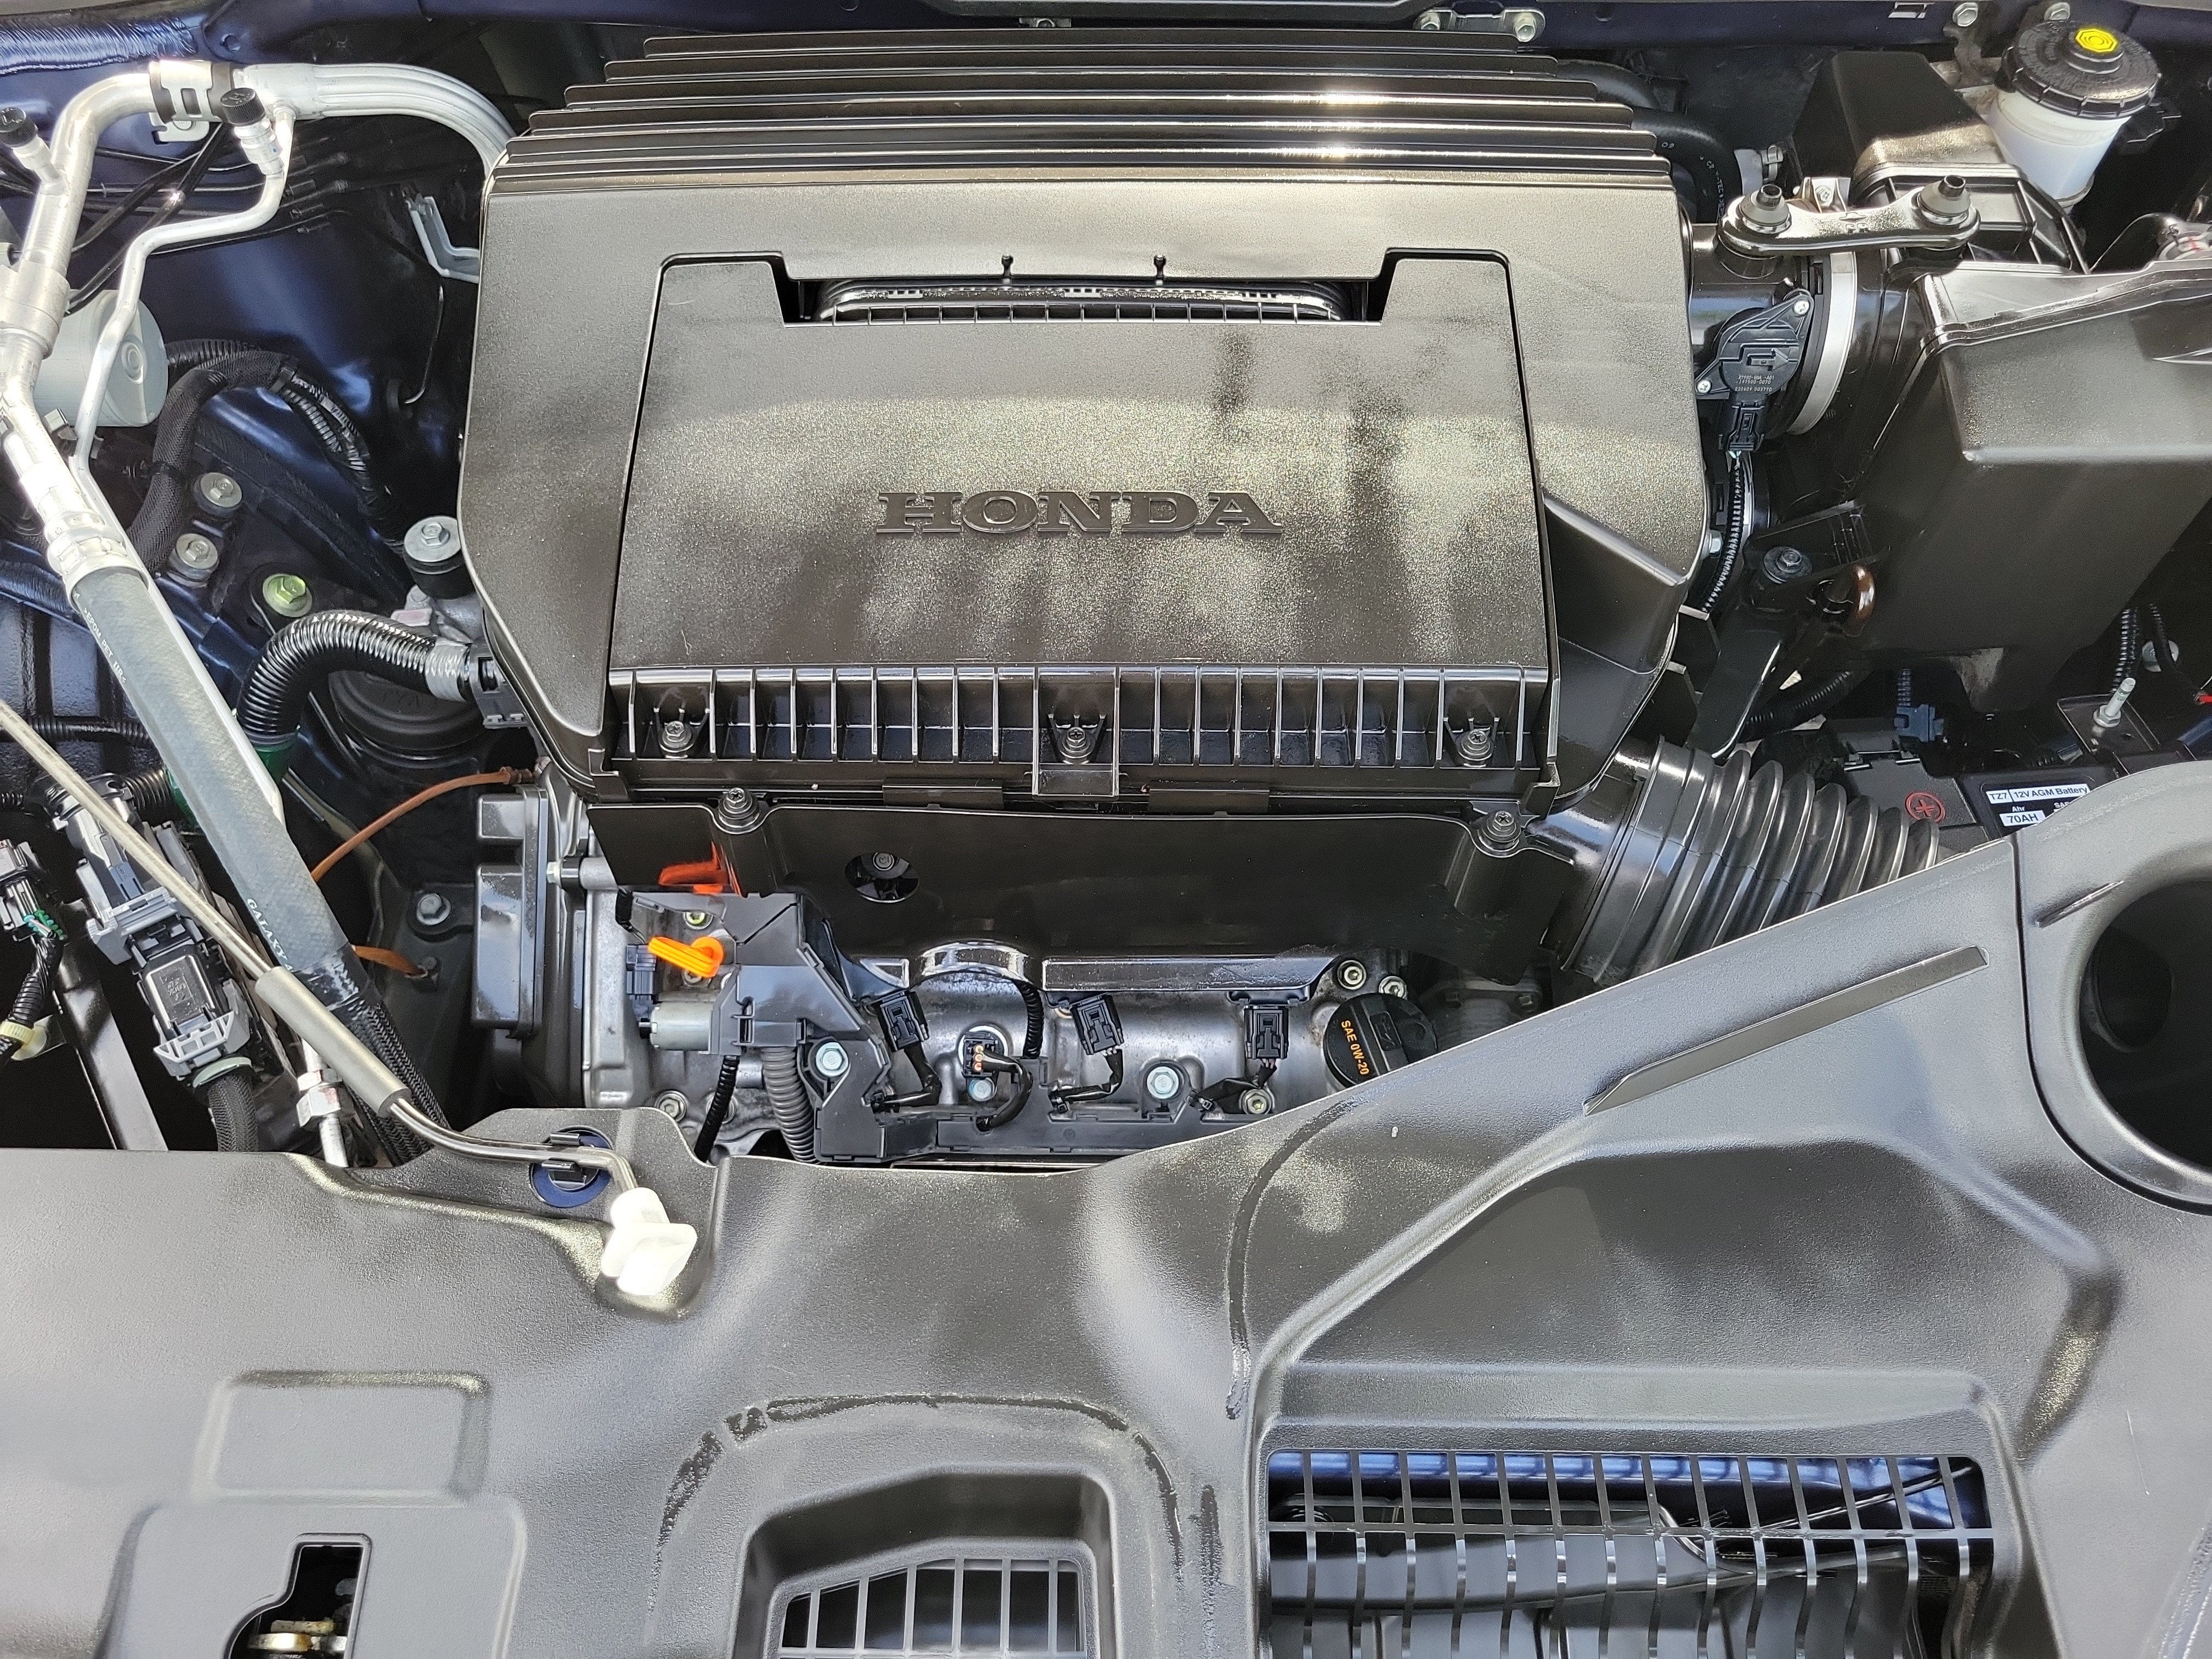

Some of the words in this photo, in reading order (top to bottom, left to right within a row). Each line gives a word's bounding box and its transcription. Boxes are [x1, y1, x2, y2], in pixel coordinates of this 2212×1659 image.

[876, 490, 1283, 534] HONDA
[1989, 792, 2008, 800] TZ7
[2013, 791, 2030, 799] 12V
[2032, 789, 2055, 797] AGM
[2006, 813, 2039, 823] 70AH
[247, 899, 288, 960] GALAXY
[1341, 1020, 1357, 1043] SAE
[1351, 1043, 1369, 1075] 0W-20
